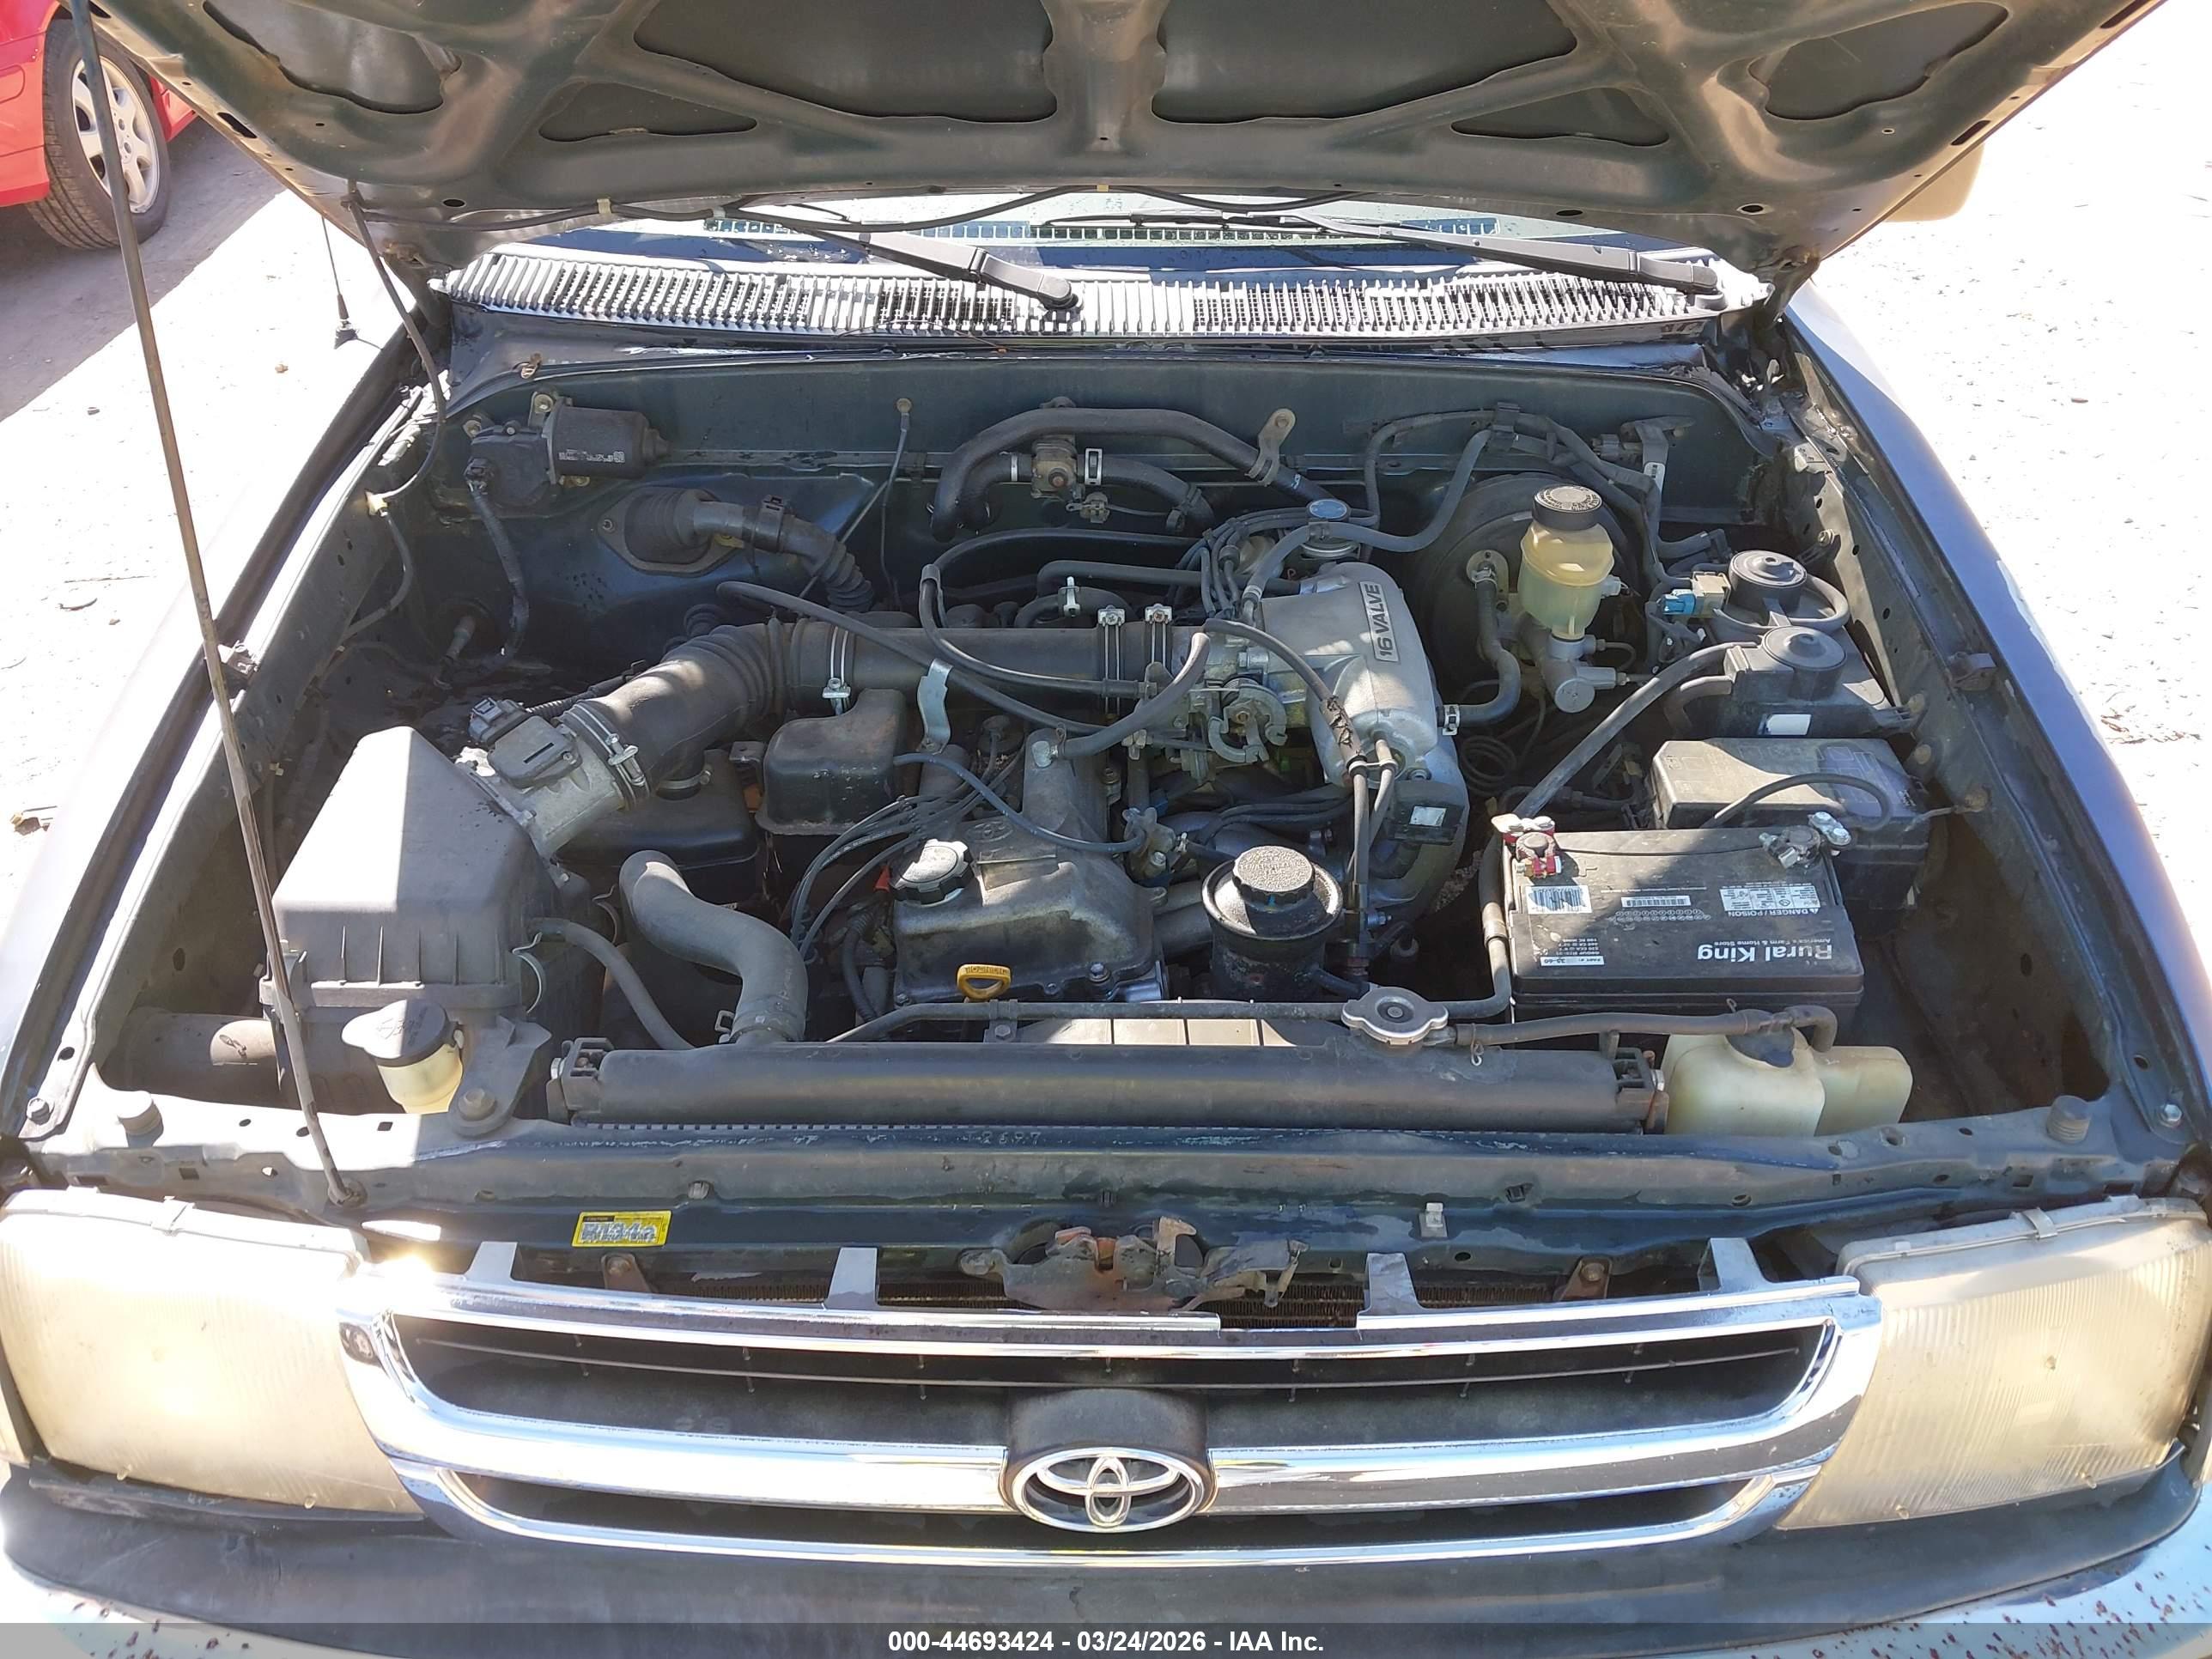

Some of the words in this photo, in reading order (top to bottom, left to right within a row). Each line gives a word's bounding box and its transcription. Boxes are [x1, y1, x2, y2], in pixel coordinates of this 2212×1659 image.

[1364, 584, 1389, 635] VALVE
[1376, 637, 1394, 657] 16
[1696, 944, 1756, 963] King
[1765, 944, 1833, 962] Rural
